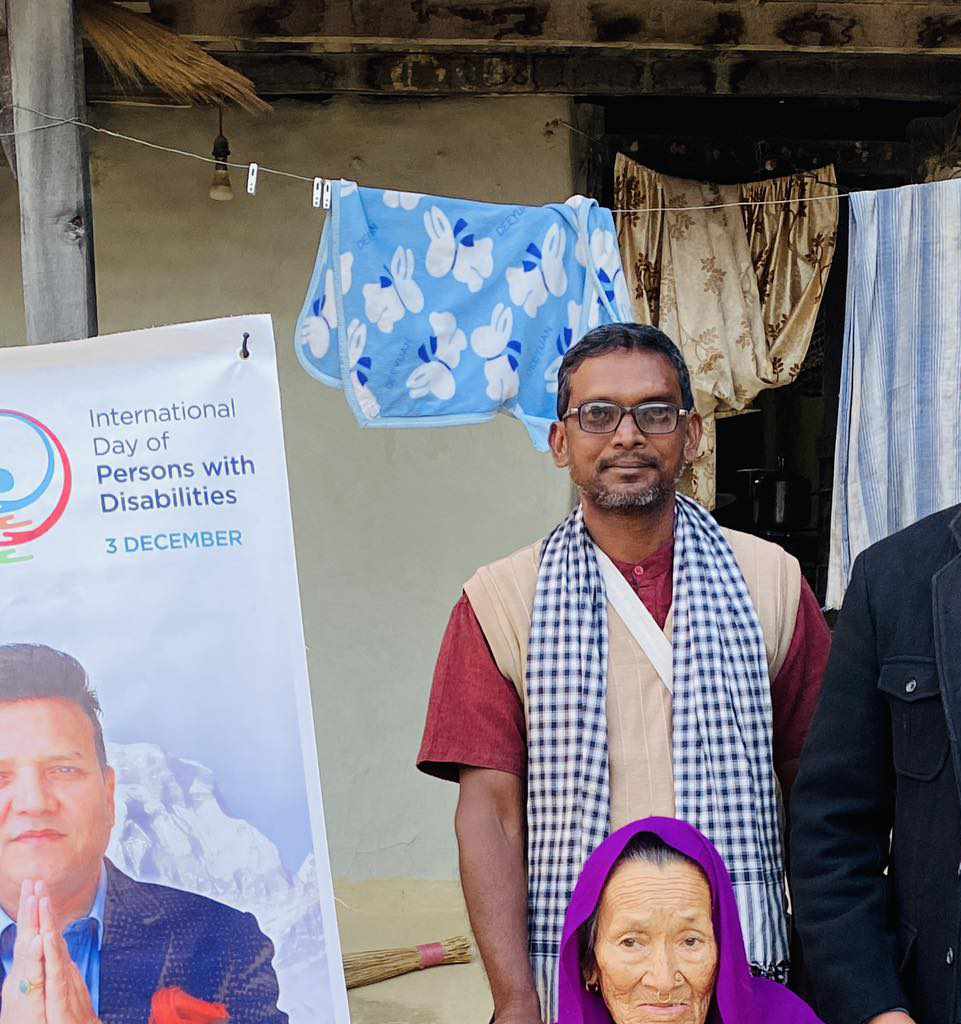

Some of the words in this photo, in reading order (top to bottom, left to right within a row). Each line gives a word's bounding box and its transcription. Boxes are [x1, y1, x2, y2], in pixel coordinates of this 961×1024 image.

[89, 398, 237, 428] International
[93, 437, 139, 458] Day
[147, 431, 171, 454] of
[96, 460, 195, 485] Persons
[202, 454, 256, 478] with
[100, 486, 238, 514] Disabilities
[105, 537, 118, 554] 3
[124, 529, 243, 554] DECEMBER
